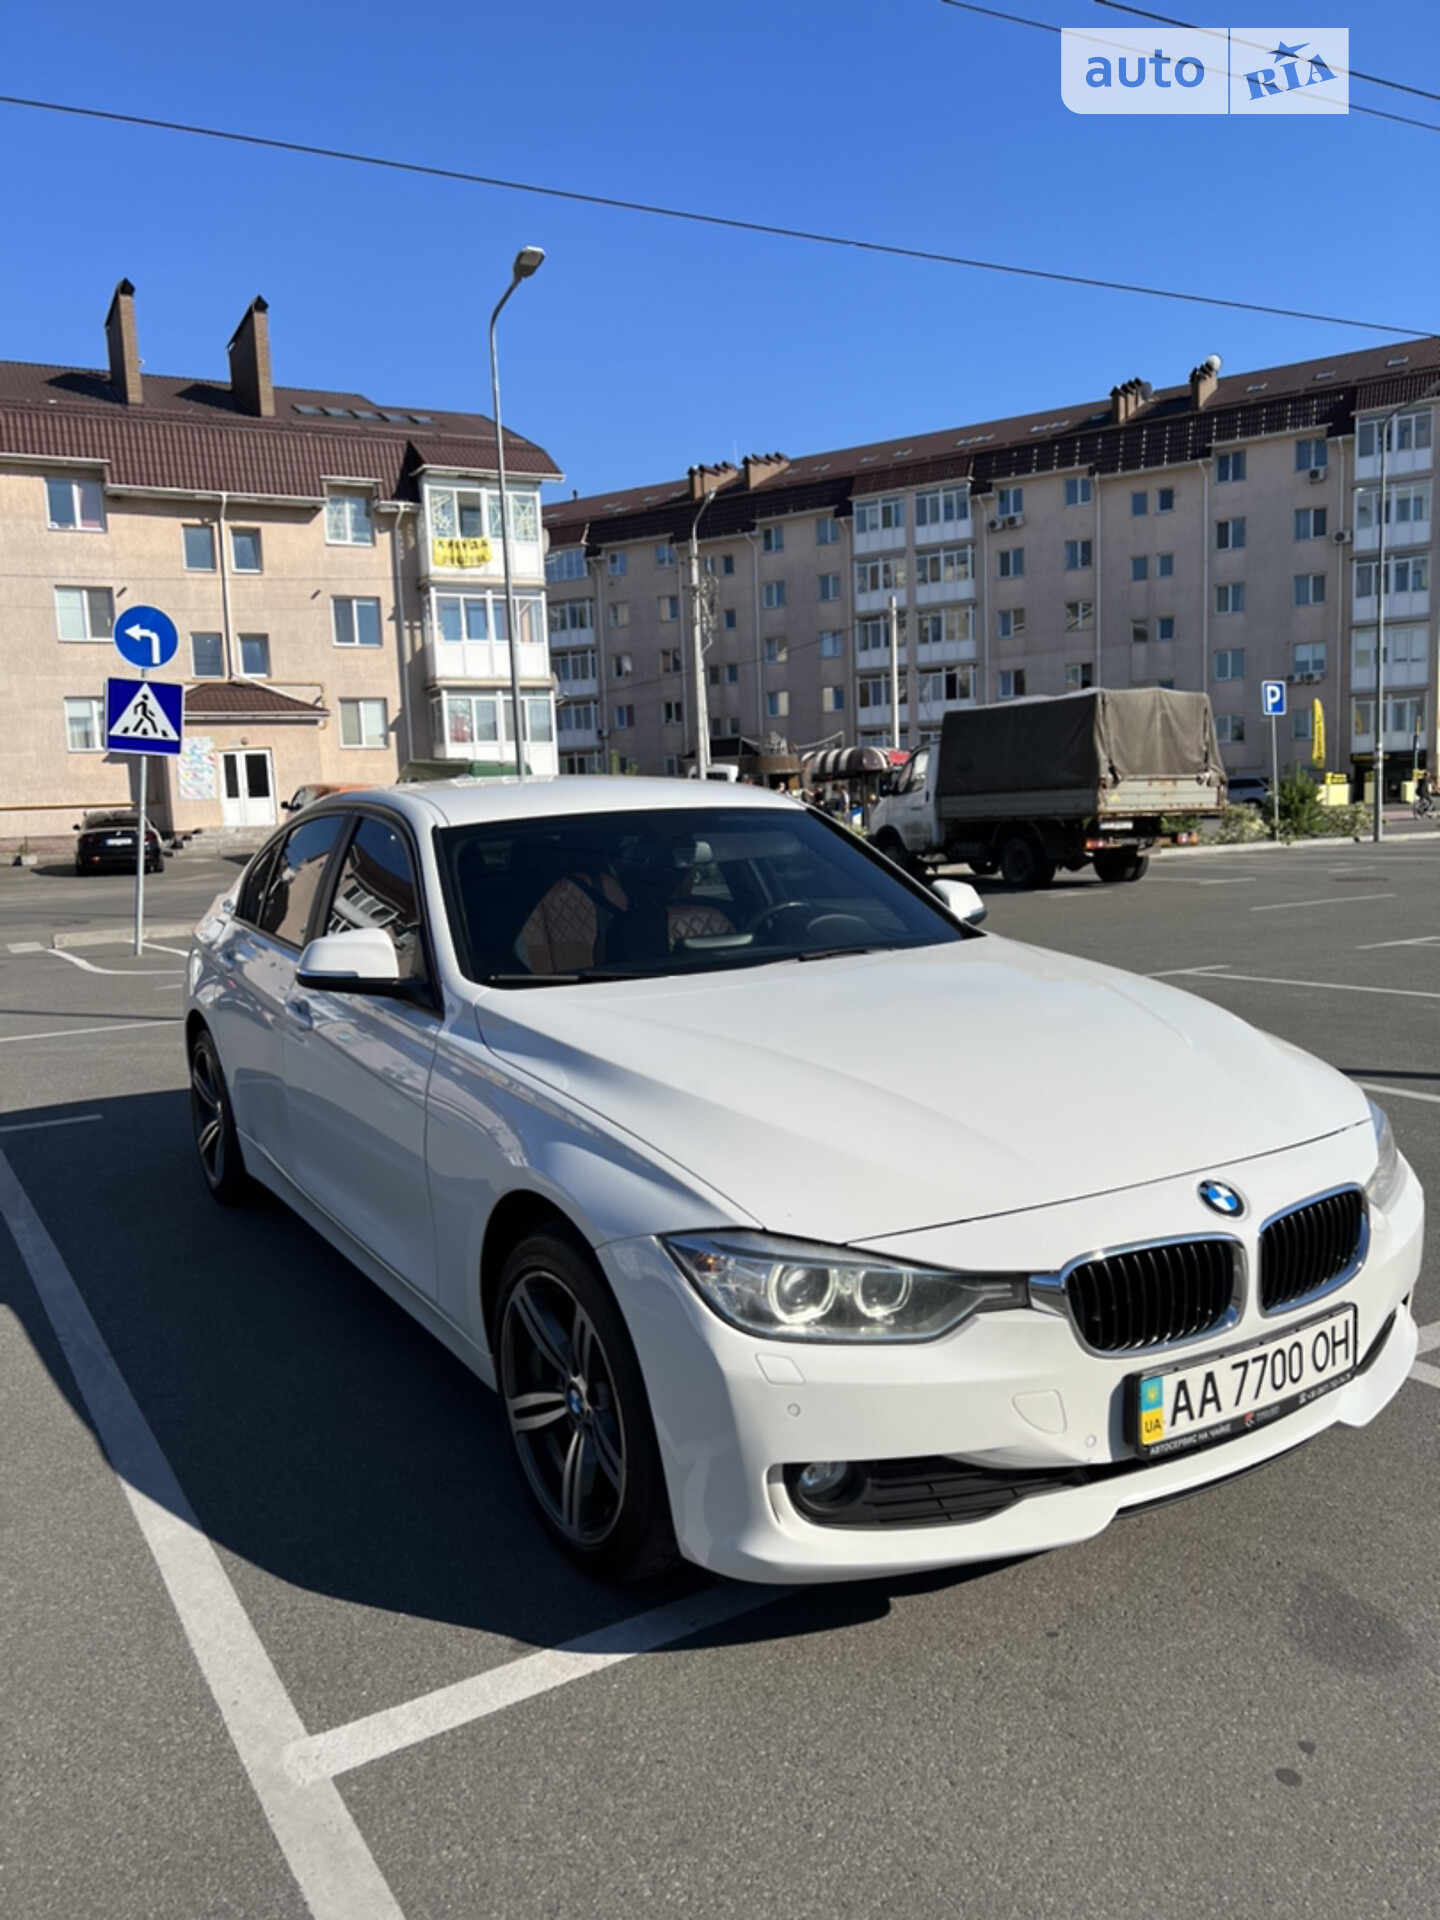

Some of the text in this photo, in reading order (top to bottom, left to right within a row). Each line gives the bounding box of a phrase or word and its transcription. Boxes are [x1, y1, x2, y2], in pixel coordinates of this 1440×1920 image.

[1266, 685, 1281, 712] P
[1170, 1371, 1222, 1427] AA
[1231, 1341, 1304, 1407] 7700
[1311, 1319, 1350, 1373] OH
[1144, 1418, 1162, 1434] UA
